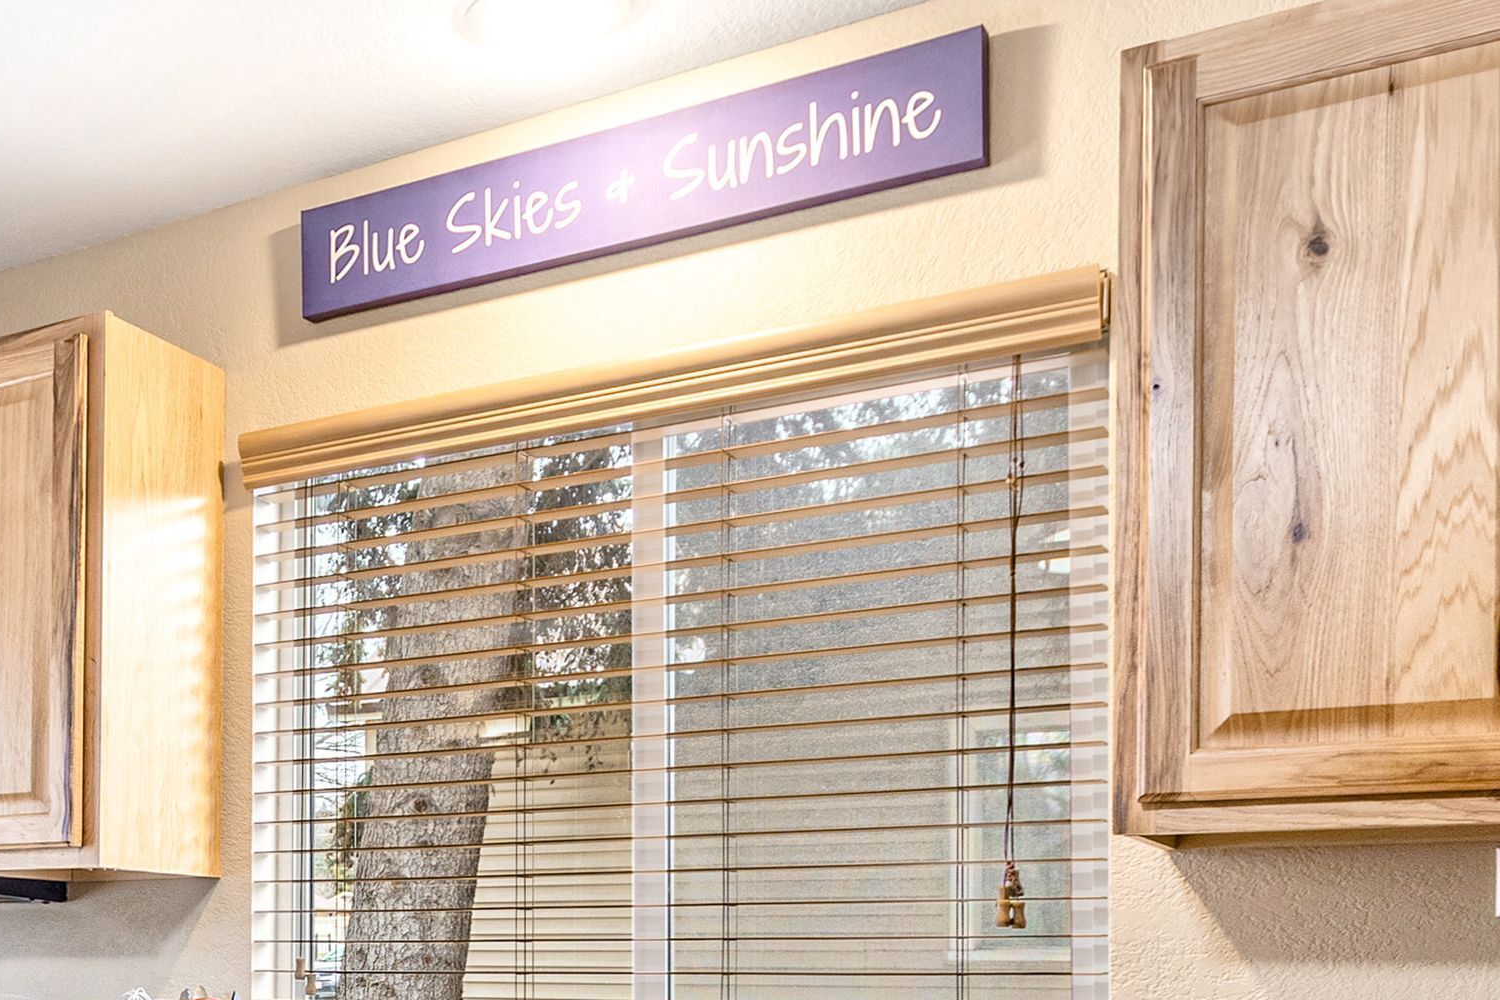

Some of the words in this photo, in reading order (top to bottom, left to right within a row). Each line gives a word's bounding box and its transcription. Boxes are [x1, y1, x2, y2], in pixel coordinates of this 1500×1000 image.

[328, 219, 425, 284] Blue
[446, 180, 582, 254] Skies
[662, 90, 943, 200] Sunshine
